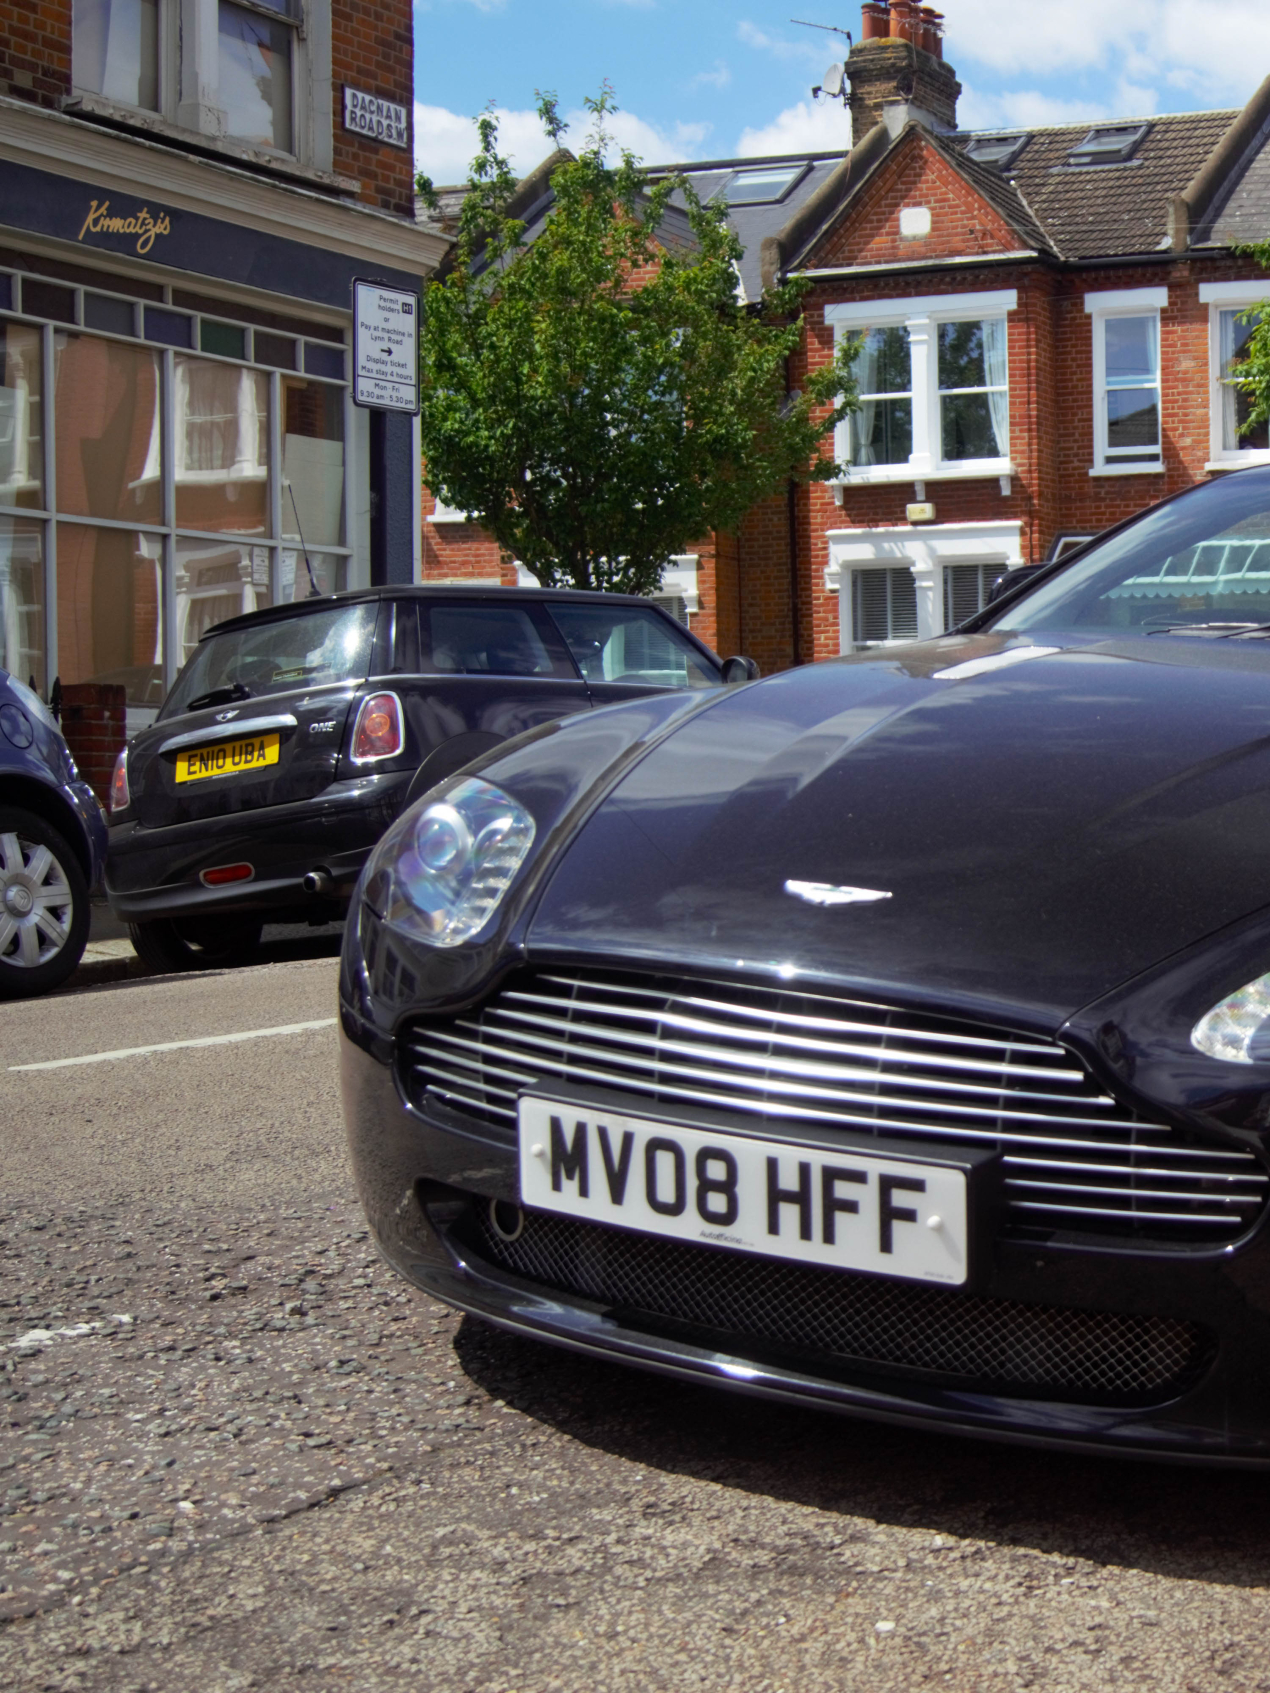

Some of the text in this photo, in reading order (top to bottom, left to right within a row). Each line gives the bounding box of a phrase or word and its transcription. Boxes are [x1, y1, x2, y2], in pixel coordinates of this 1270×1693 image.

[350, 110, 384, 136] ROAD
[379, 295, 399, 305] Permit
[378, 304, 400, 314] holders
[403, 304, 412, 313] H1
[360, 322, 371, 332] Pay
[381, 327, 405, 337] machine
[370, 333, 403, 346] Lynn Road
[366, 355, 407, 369] Display ticket
[361, 365, 373, 373] Max
[396, 372, 412, 381] hours
[374, 382, 387, 391] Mon
[360, 390, 374, 399] 9.30
[390, 395, 403, 404] 5.30
[309, 721, 336, 733] ONE
[187, 740, 266, 776] EN10 UBA
[550, 1115, 926, 1254] MV08 HFF
